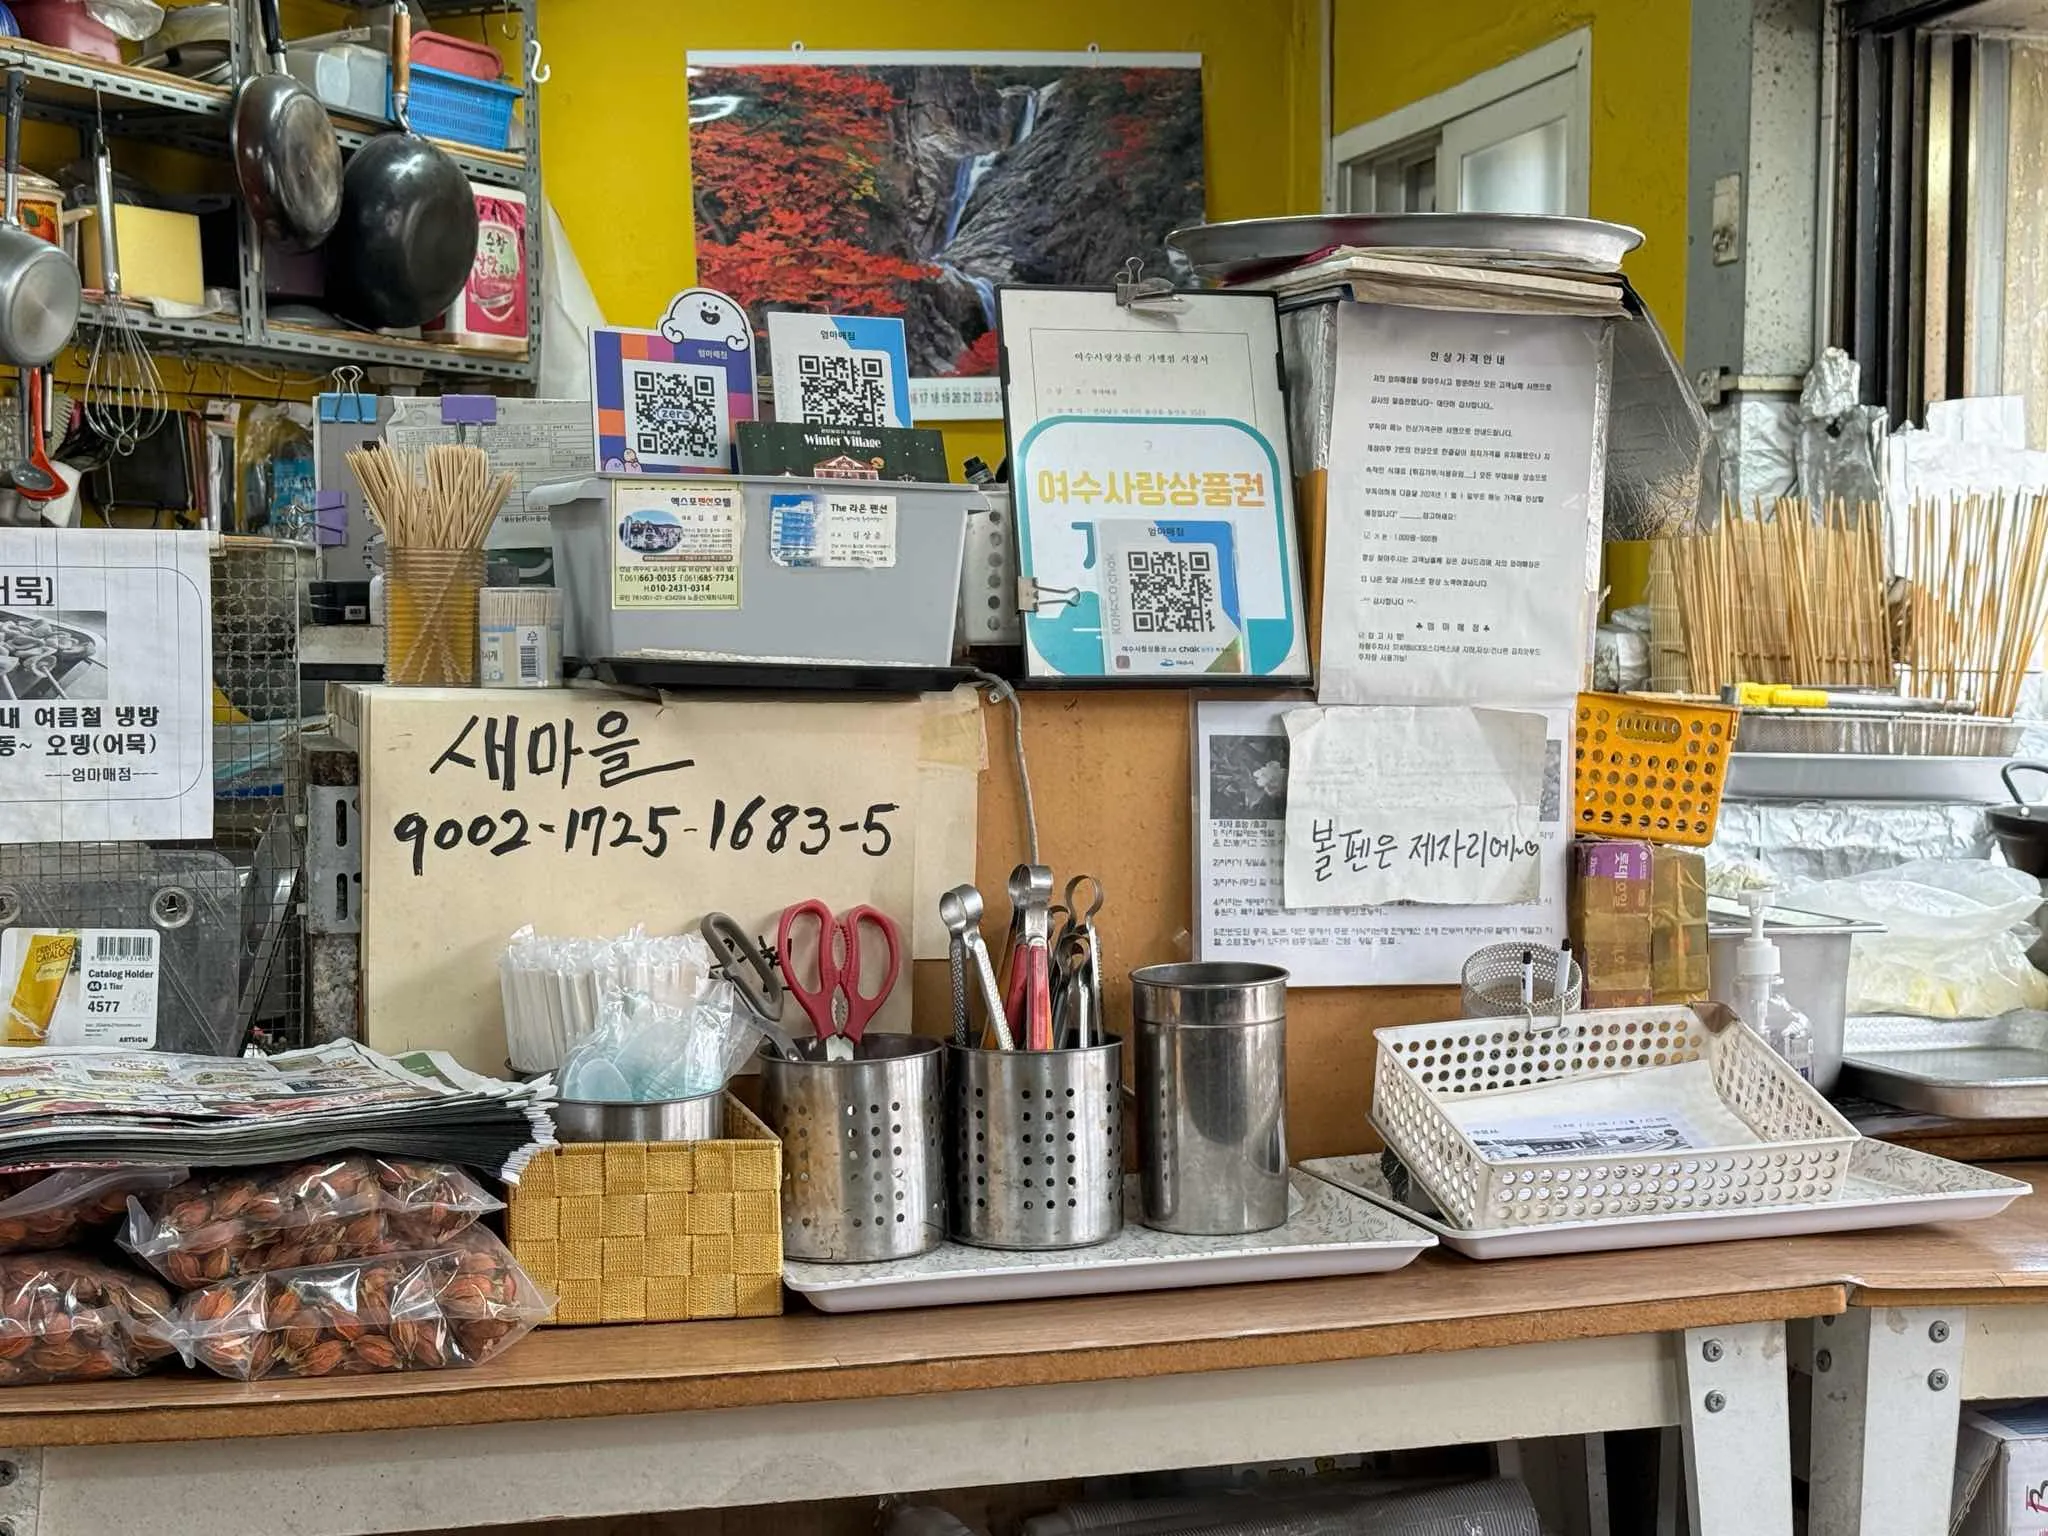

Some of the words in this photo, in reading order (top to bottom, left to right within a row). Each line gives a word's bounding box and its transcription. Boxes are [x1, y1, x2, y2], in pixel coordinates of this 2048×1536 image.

[804, 434, 842, 446] Winter
[843, 436, 882, 449] Village
[1038, 470, 1266, 509] 여수사랑상품권
[830, 504, 847, 512] The
[35, 707, 102, 728] 여름철
[116, 706, 160, 728] 냉방
[45, 734, 157, 757] 오뎅(어묵)
[430, 709, 696, 791] 새마을
[394, 794, 900, 877] 9002-1725-1683-5
[1311, 818, 1399, 883] 볼펜은
[88, 970, 123, 980] Catalog
[124, 970, 154, 979] Holder
[87, 1001, 121, 1013] 4577
